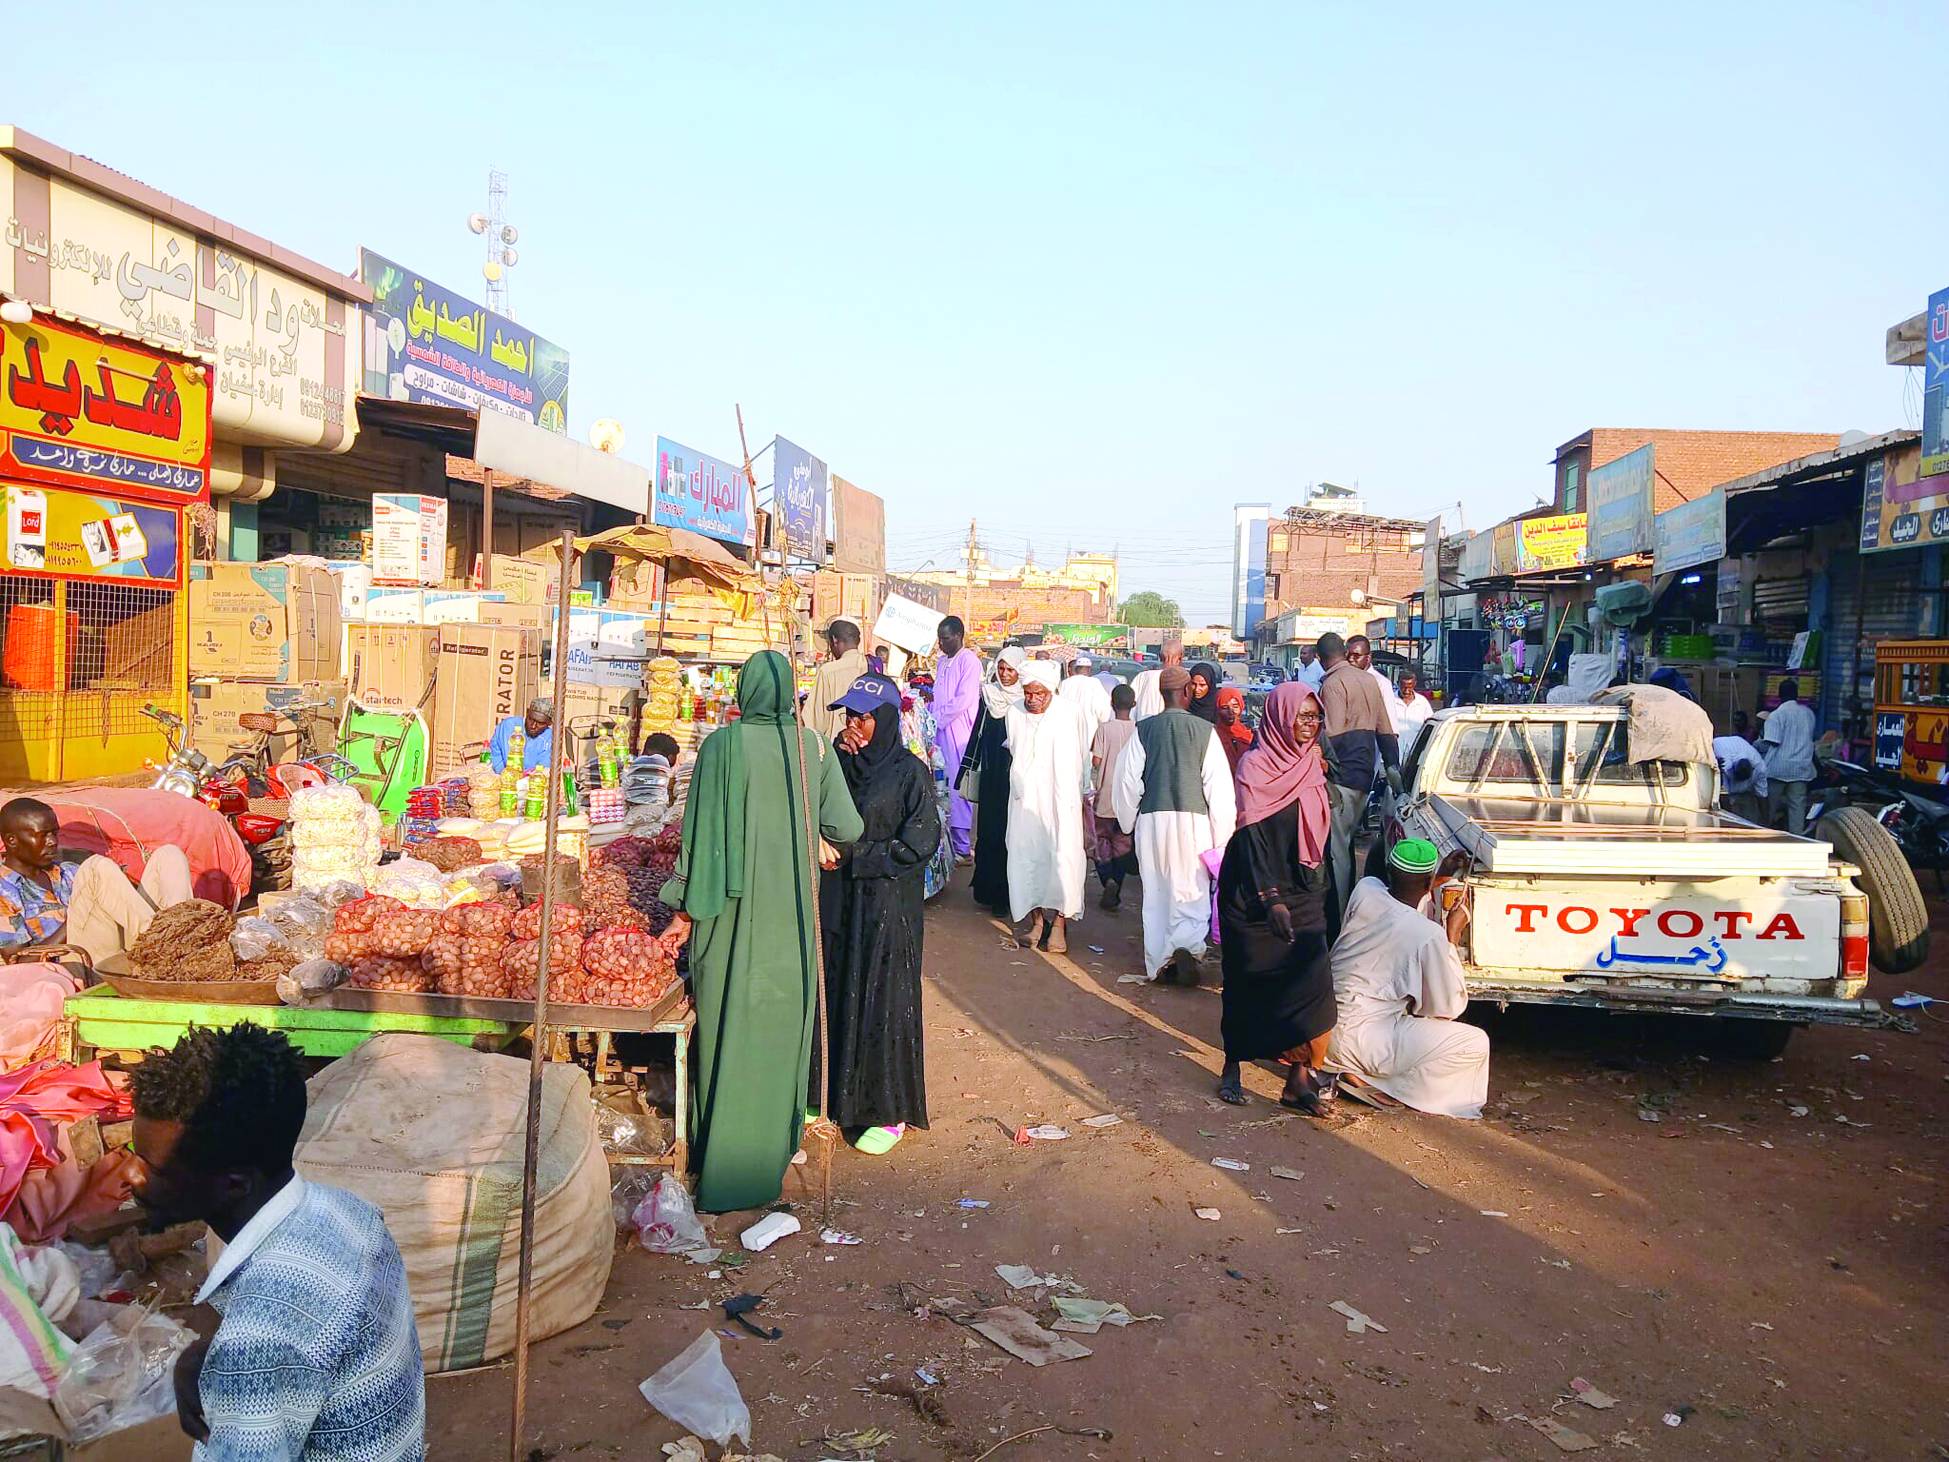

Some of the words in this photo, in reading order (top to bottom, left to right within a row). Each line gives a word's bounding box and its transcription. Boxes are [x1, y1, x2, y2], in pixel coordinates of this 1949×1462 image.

[116, 238, 258, 325] القاضي
[406, 278, 487, 356] الصديق
[689, 458, 742, 514] المبارك
[22, 516, 40, 529] Lord
[365, 695, 403, 706] startech
[850, 679, 884, 696] CCI
[1505, 903, 1805, 941] TOYOTA
